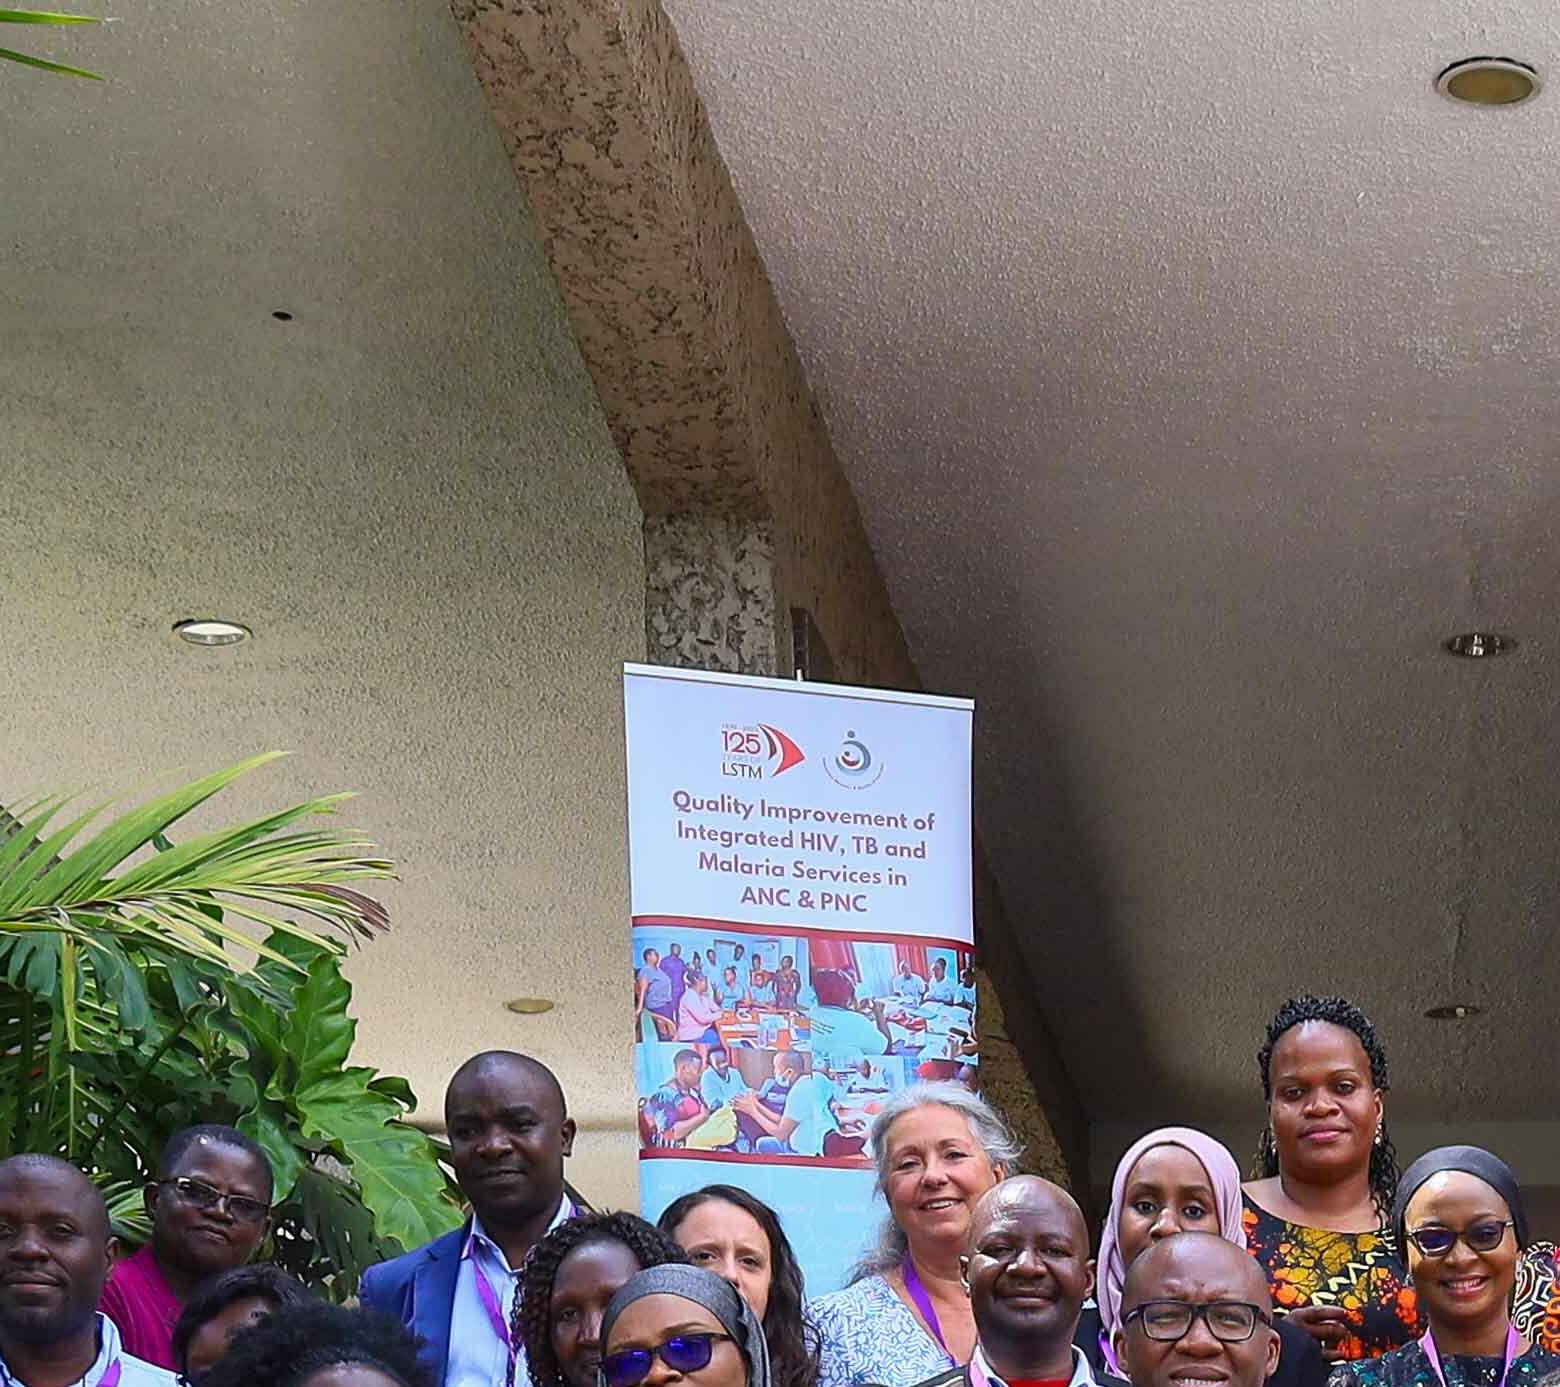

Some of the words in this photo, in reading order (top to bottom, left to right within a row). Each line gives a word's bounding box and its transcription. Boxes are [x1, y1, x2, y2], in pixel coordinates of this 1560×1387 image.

[721, 730, 761, 754] 125
[722, 761, 762, 780] LSTM
[673, 790, 754, 820] Quality
[761, 799, 907, 830] Improvement
[912, 813, 935, 831] of
[677, 820, 794, 848] Integrated
[800, 832, 845, 856] HIV,
[851, 836, 878, 855] TB
[885, 841, 926, 859] and
[698, 852, 785, 877] Malaria
[792, 860, 881, 884] Services
[888, 867, 907, 886] in
[741, 886, 790, 907] ANC
[797, 890, 815, 909] &
[821, 892, 868, 912] PNC
